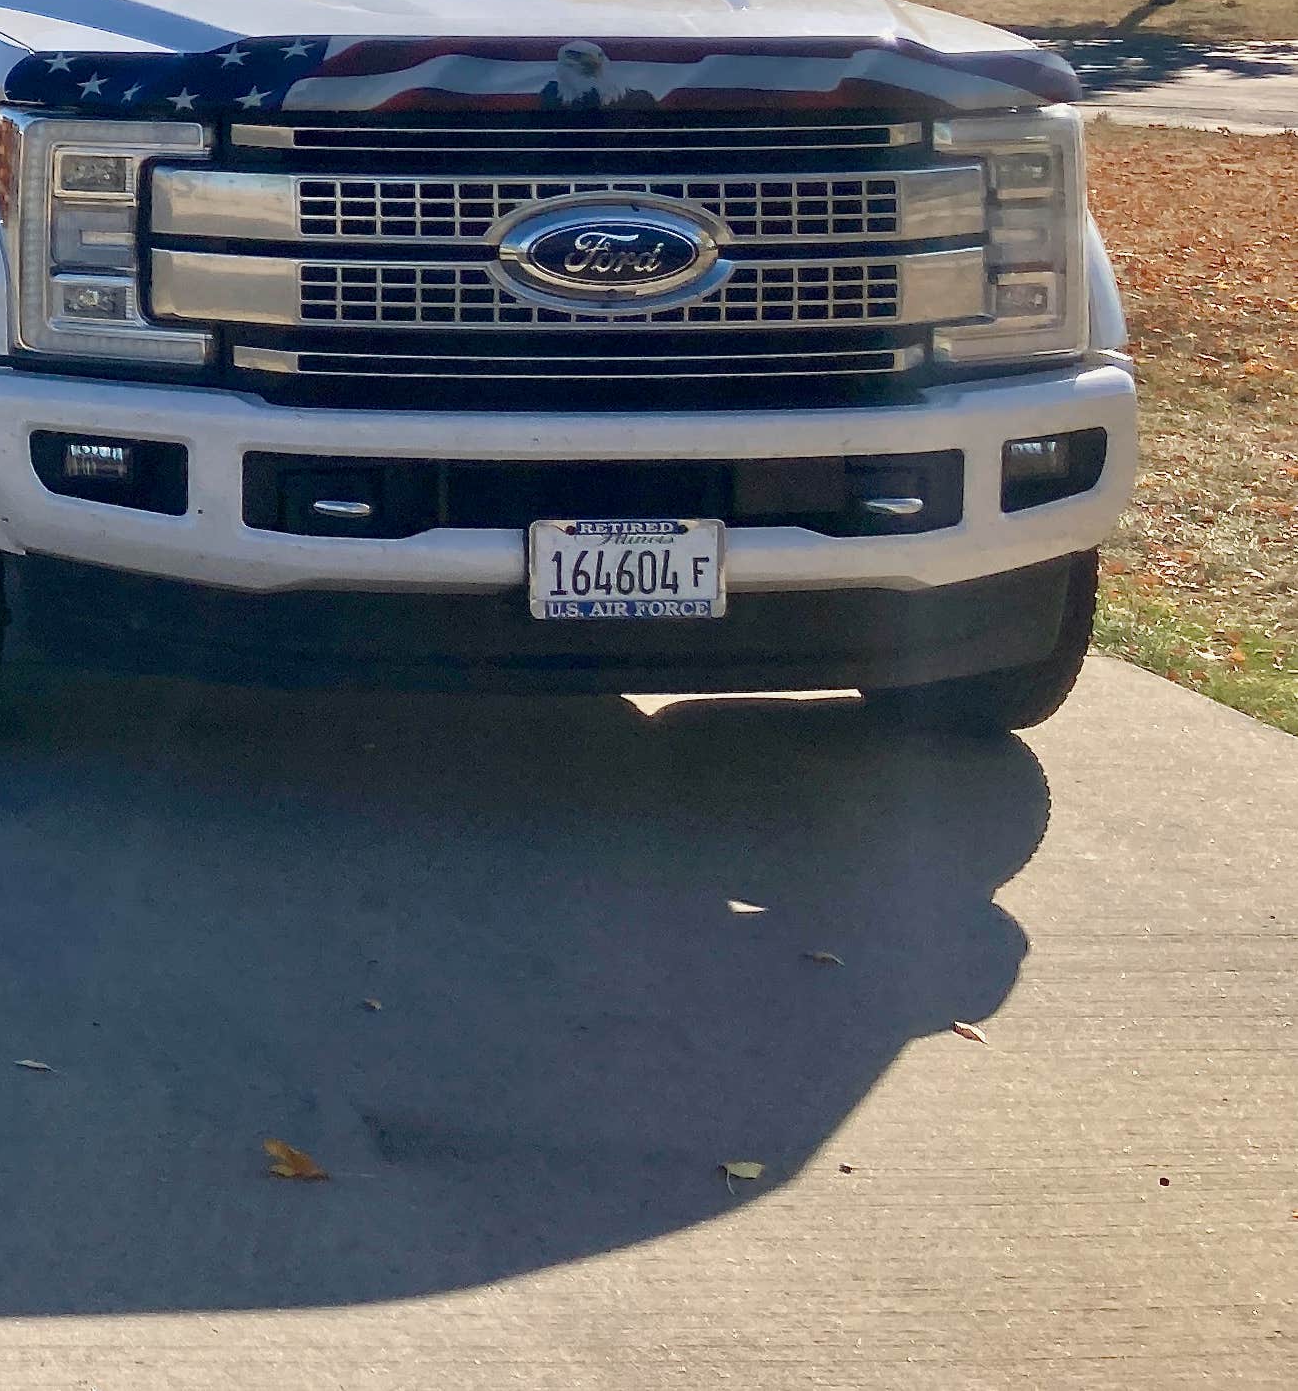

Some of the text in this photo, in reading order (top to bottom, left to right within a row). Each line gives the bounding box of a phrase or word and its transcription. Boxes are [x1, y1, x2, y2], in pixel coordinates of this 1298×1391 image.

[563, 230, 665, 274] Ford
[579, 521, 675, 534] RETIRED
[549, 549, 710, 596] 164604 F
[548, 600, 709, 617] U.S. AIR FORCE
